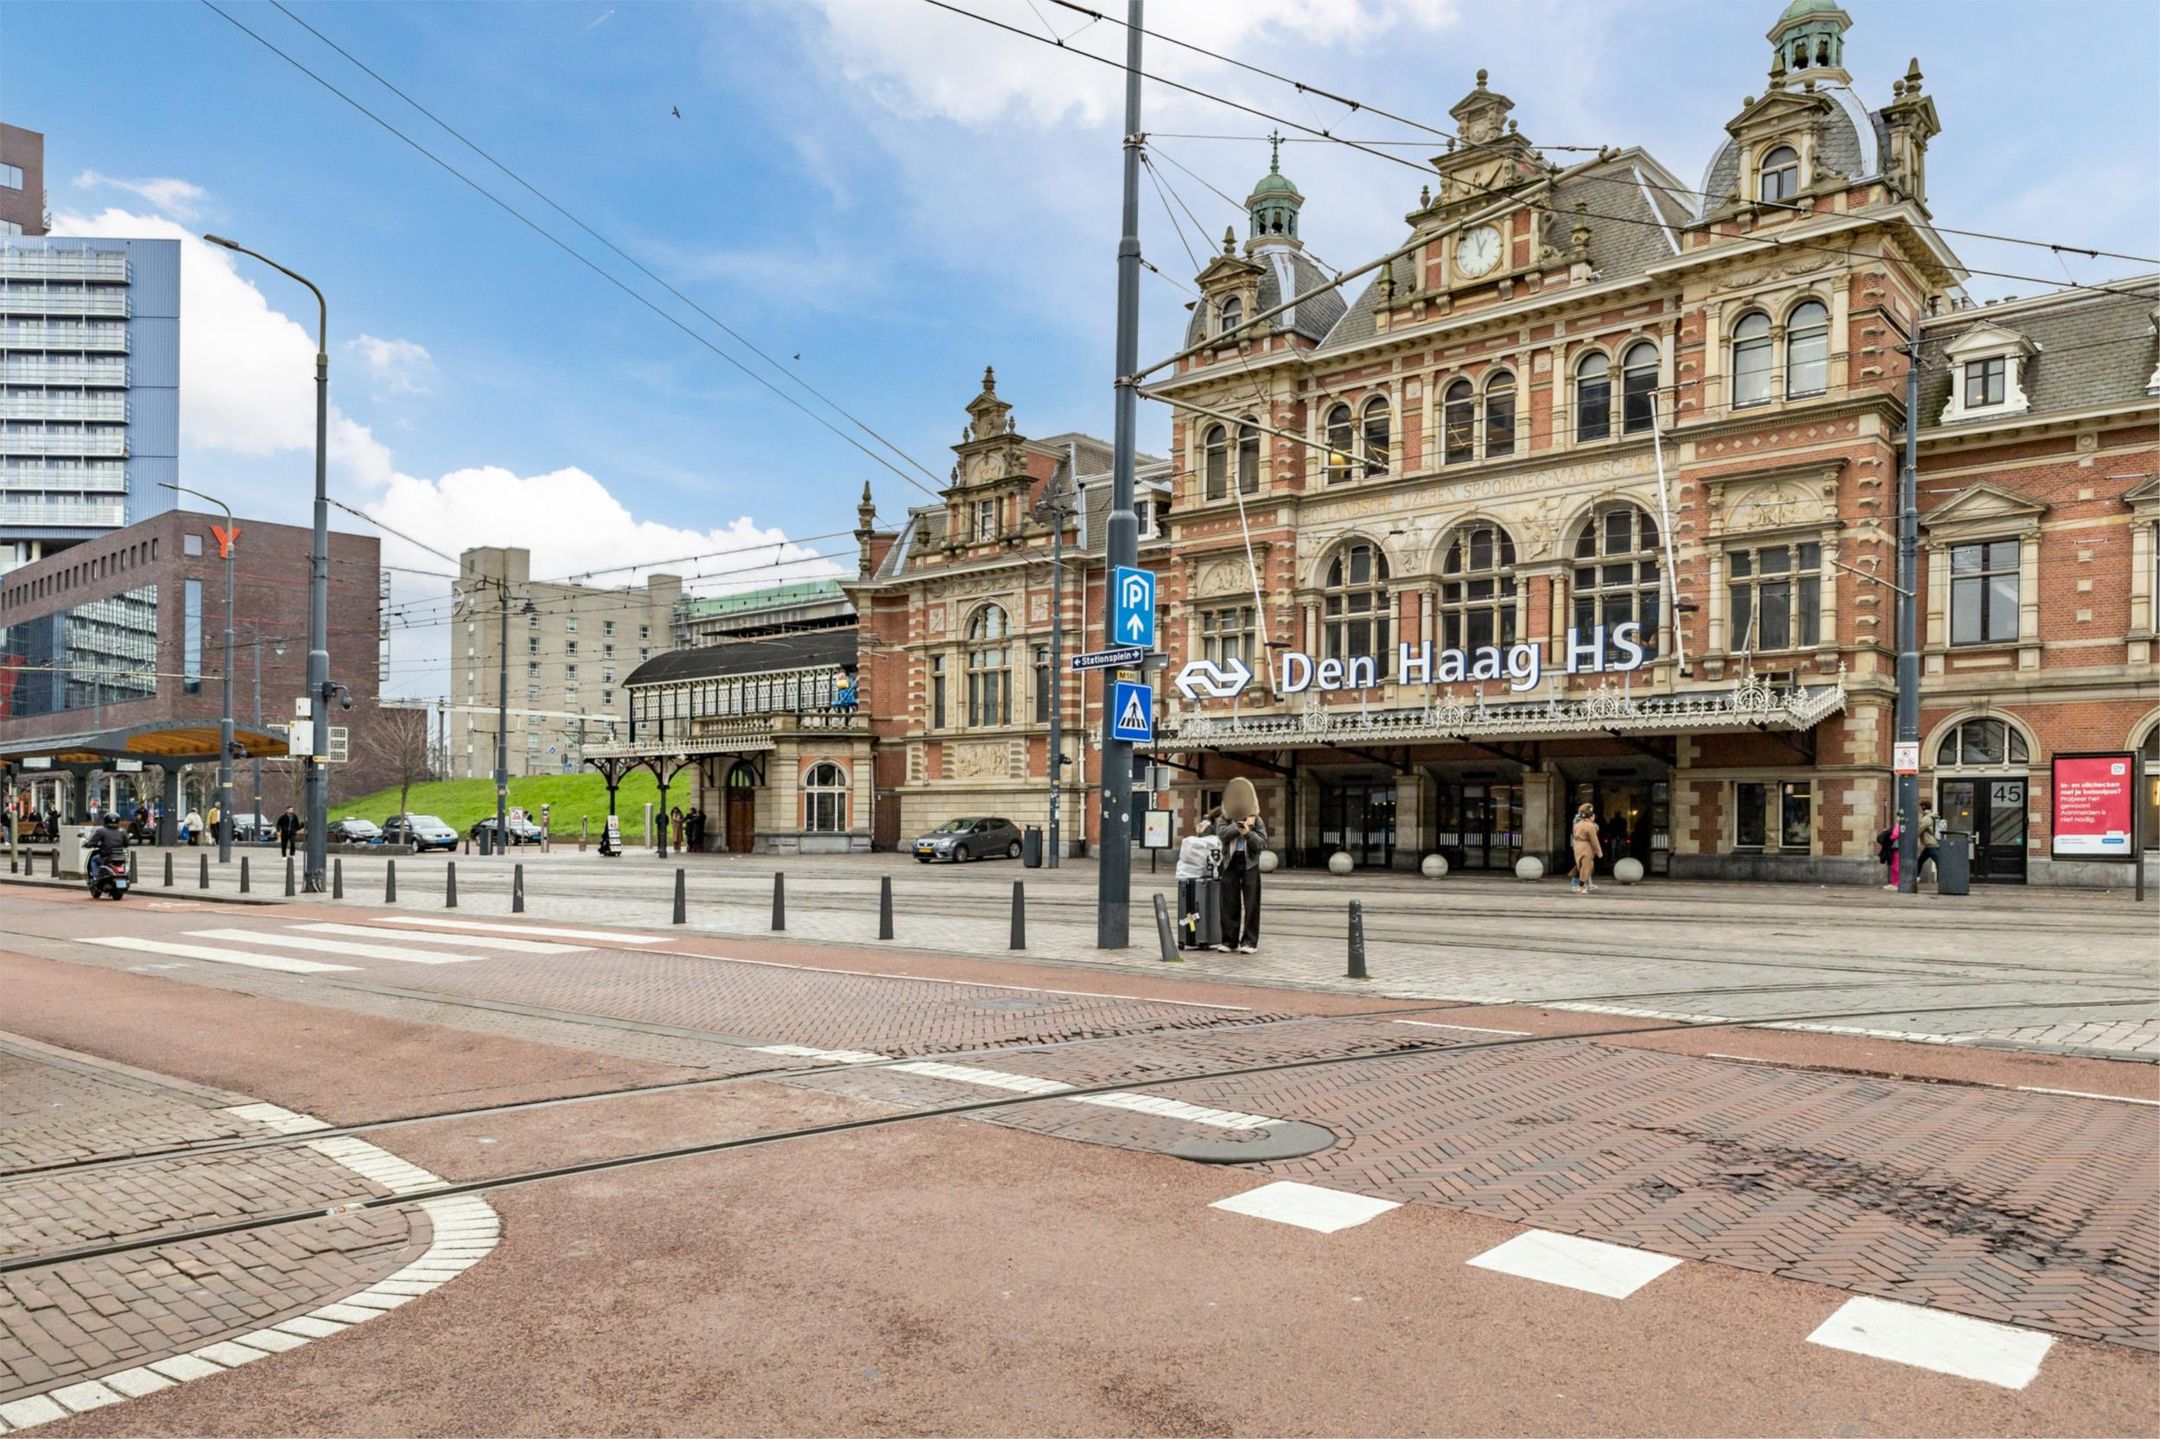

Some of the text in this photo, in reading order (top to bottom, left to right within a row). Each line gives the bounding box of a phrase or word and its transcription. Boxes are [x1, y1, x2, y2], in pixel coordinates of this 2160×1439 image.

[1081, 650, 1132, 666] Stationsplein
[1281, 622, 1646, 694] Den Haag HS
[1993, 786, 2021, 802] 45
[2083, 788, 2121, 796] betaalpas?
